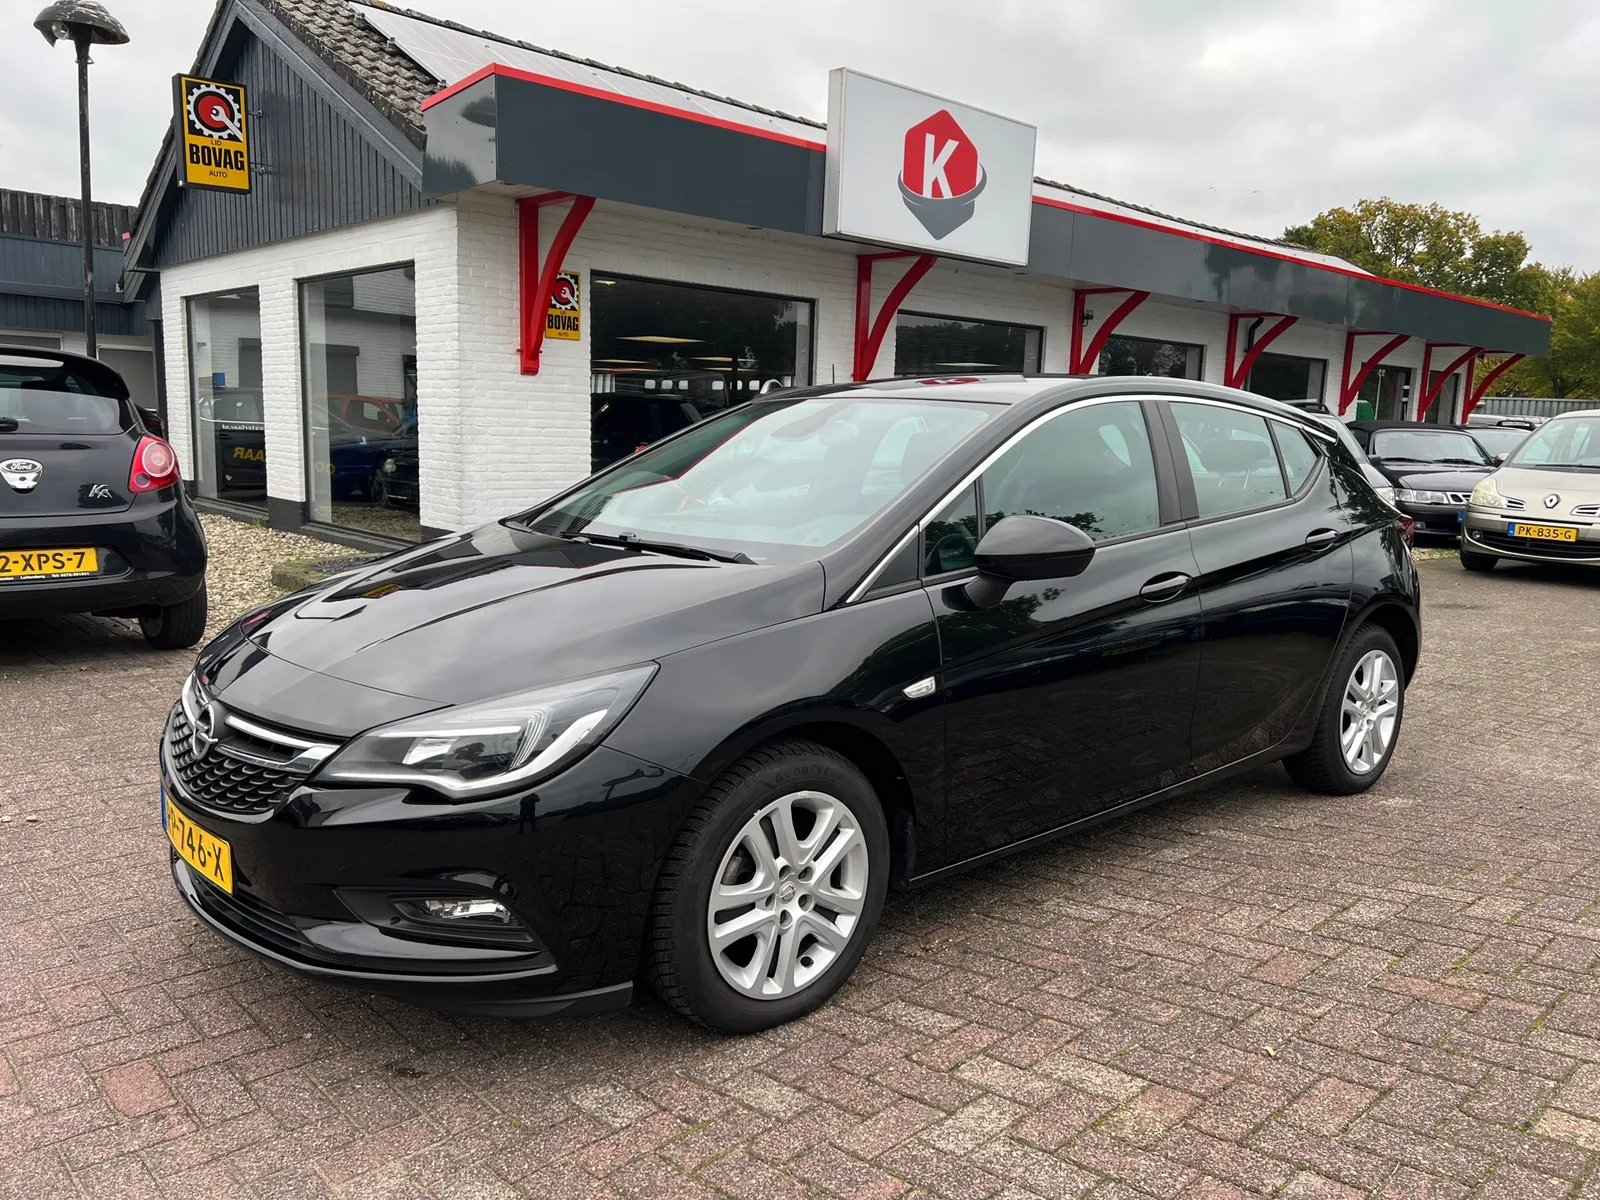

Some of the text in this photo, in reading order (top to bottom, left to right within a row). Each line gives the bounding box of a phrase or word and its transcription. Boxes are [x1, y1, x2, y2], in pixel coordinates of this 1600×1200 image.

[189, 143, 245, 171] BOVAG
[209, 170, 227, 178] AUTO
[547, 314, 579, 331] BOVAG
[10, 462, 33, 471] Ford
[1518, 526, 1572, 540] PK-835-G
[0, 551, 86, 573] 2-XPS-7
